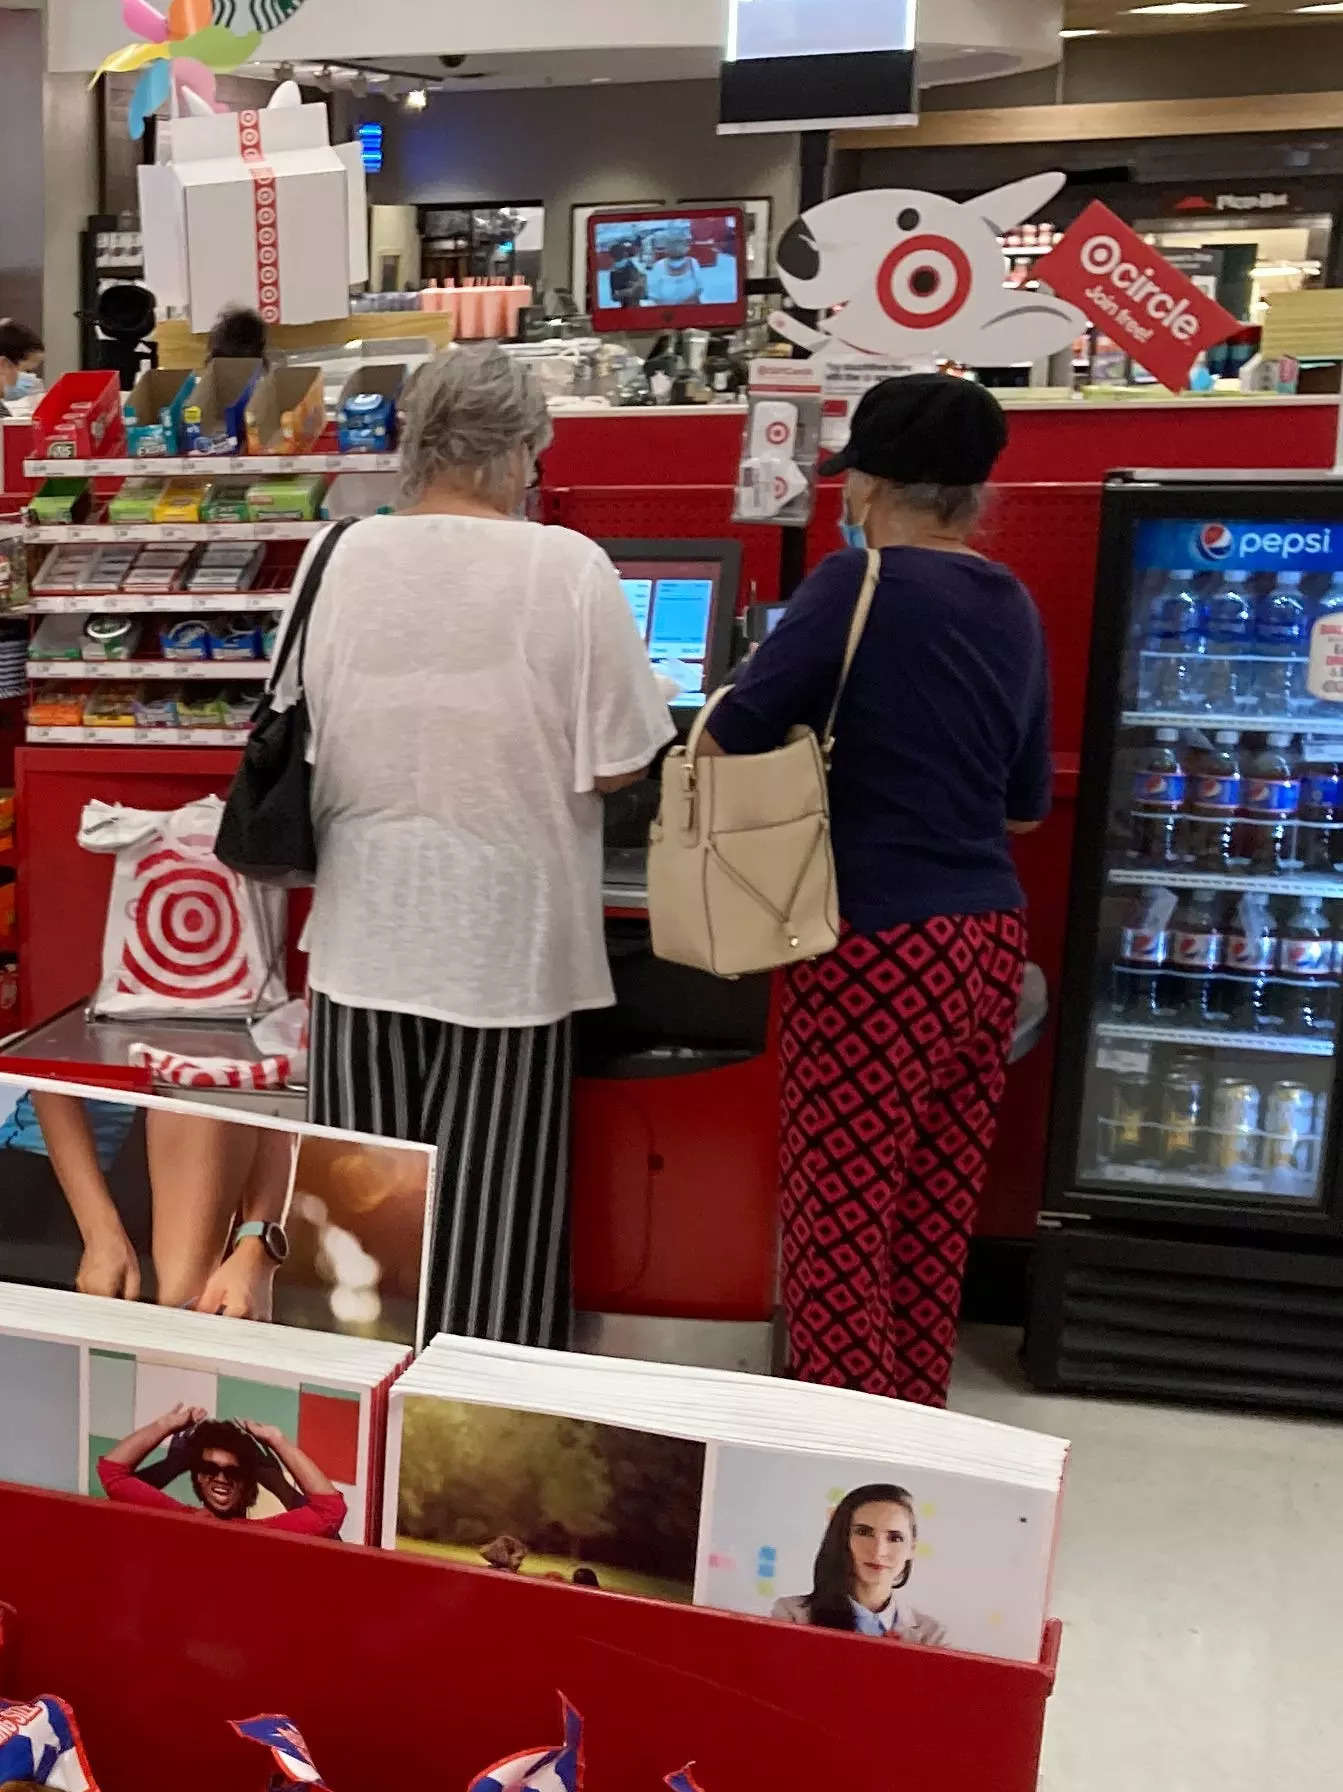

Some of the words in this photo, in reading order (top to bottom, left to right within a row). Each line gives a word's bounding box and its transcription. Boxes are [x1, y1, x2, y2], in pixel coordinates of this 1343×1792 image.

[1085, 285, 1118, 316] Join
[1111, 262, 1199, 342] circle
[1238, 527, 1332, 558] pepsi
